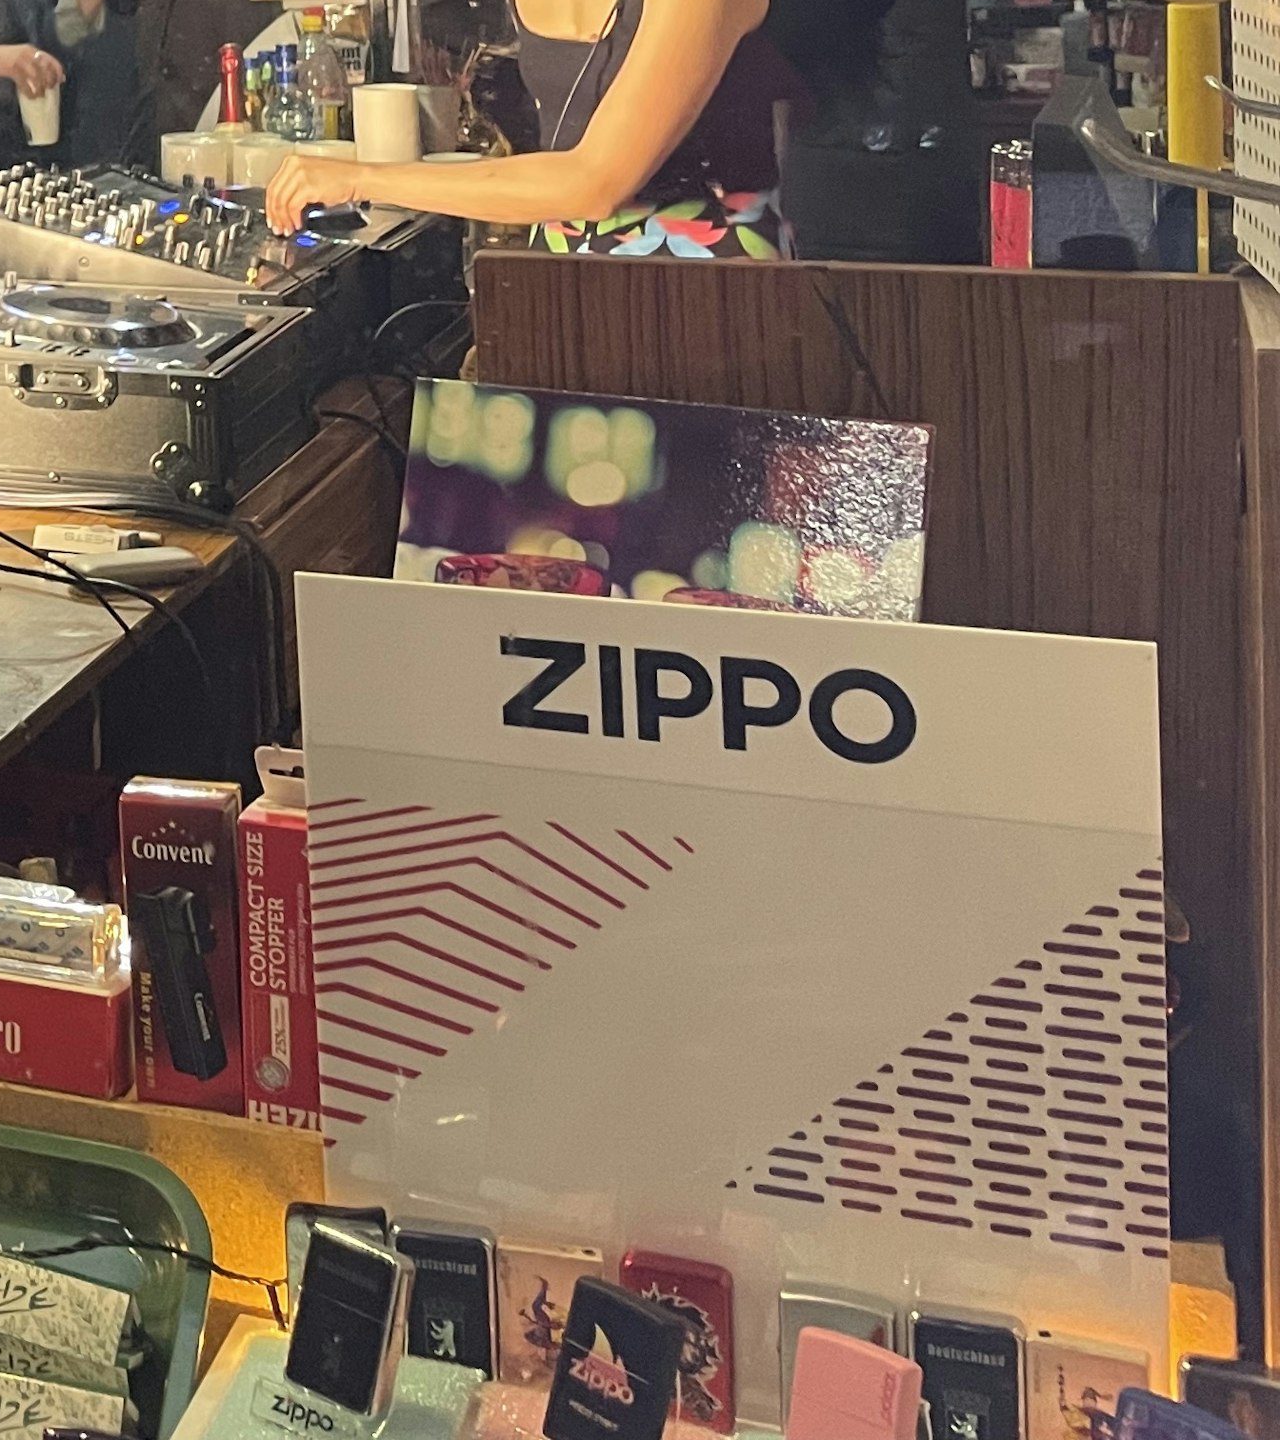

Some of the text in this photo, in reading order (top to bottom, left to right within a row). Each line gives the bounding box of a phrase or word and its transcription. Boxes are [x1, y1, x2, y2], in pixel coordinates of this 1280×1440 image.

[498, 633, 918, 765] ZIPPO
[131, 835, 216, 866] Convent
[245, 831, 268, 987] COMPACT SIZE
[267, 897, 287, 990] STOPFER
[139, 971, 156, 1089] Make your own
